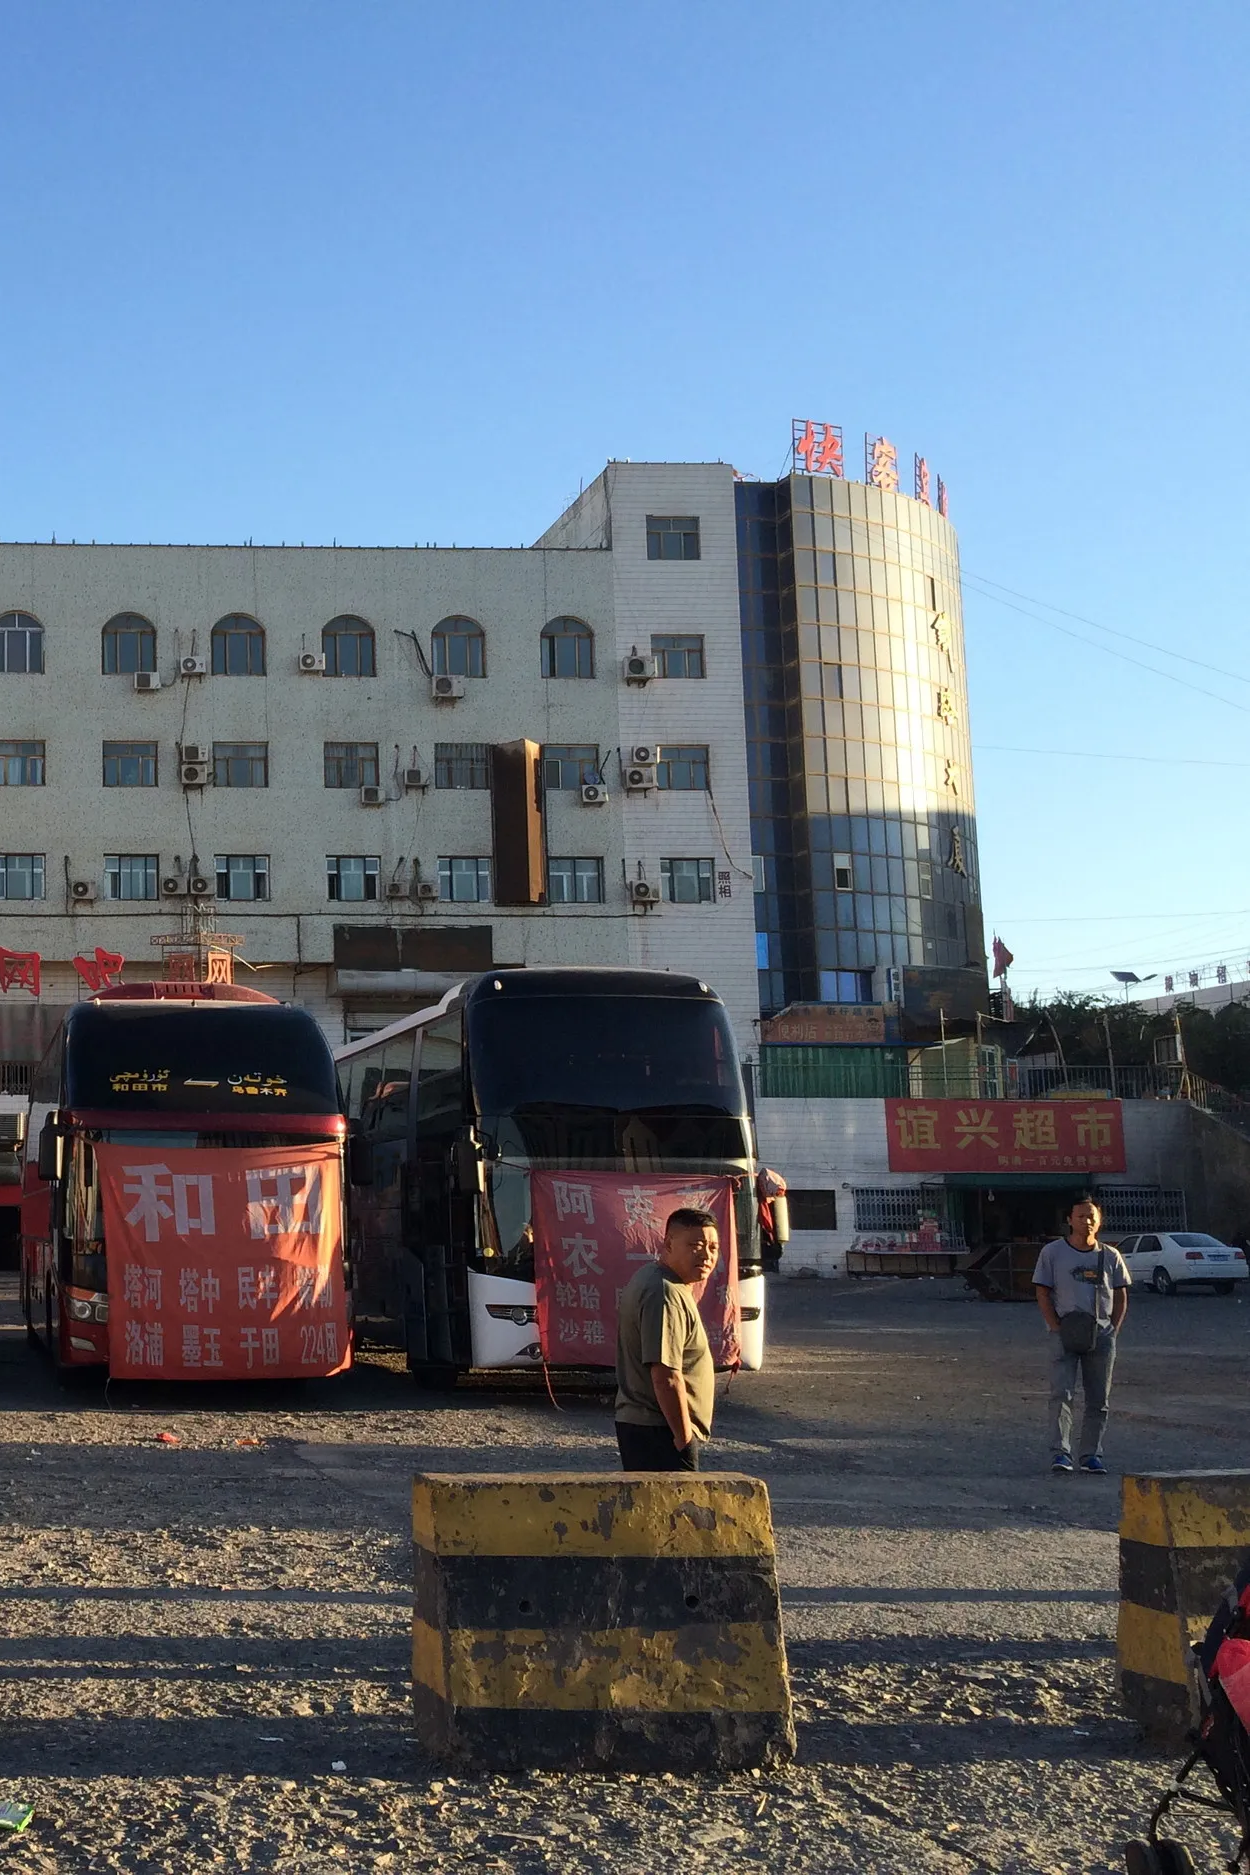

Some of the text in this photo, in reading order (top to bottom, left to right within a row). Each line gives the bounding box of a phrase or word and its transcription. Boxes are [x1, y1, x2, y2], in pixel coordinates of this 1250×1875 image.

[718, 871, 732, 898] 照相
[112, 1083, 288, 1097] 和田市 乌鲁木齐
[894, 1105, 1115, 1152] 谊兴超市
[121, 1163, 325, 1242] 和田
[124, 1264, 162, 1310] 塔河
[180, 1268, 220, 1313] 塔中
[238, 1264, 278, 1310] 民丰
[556, 1281, 600, 1310] 轮胎
[125, 1320, 338, 1369] 洛浦 墨玉 于田 224团
[558, 1318, 605, 1345] 沙雅
